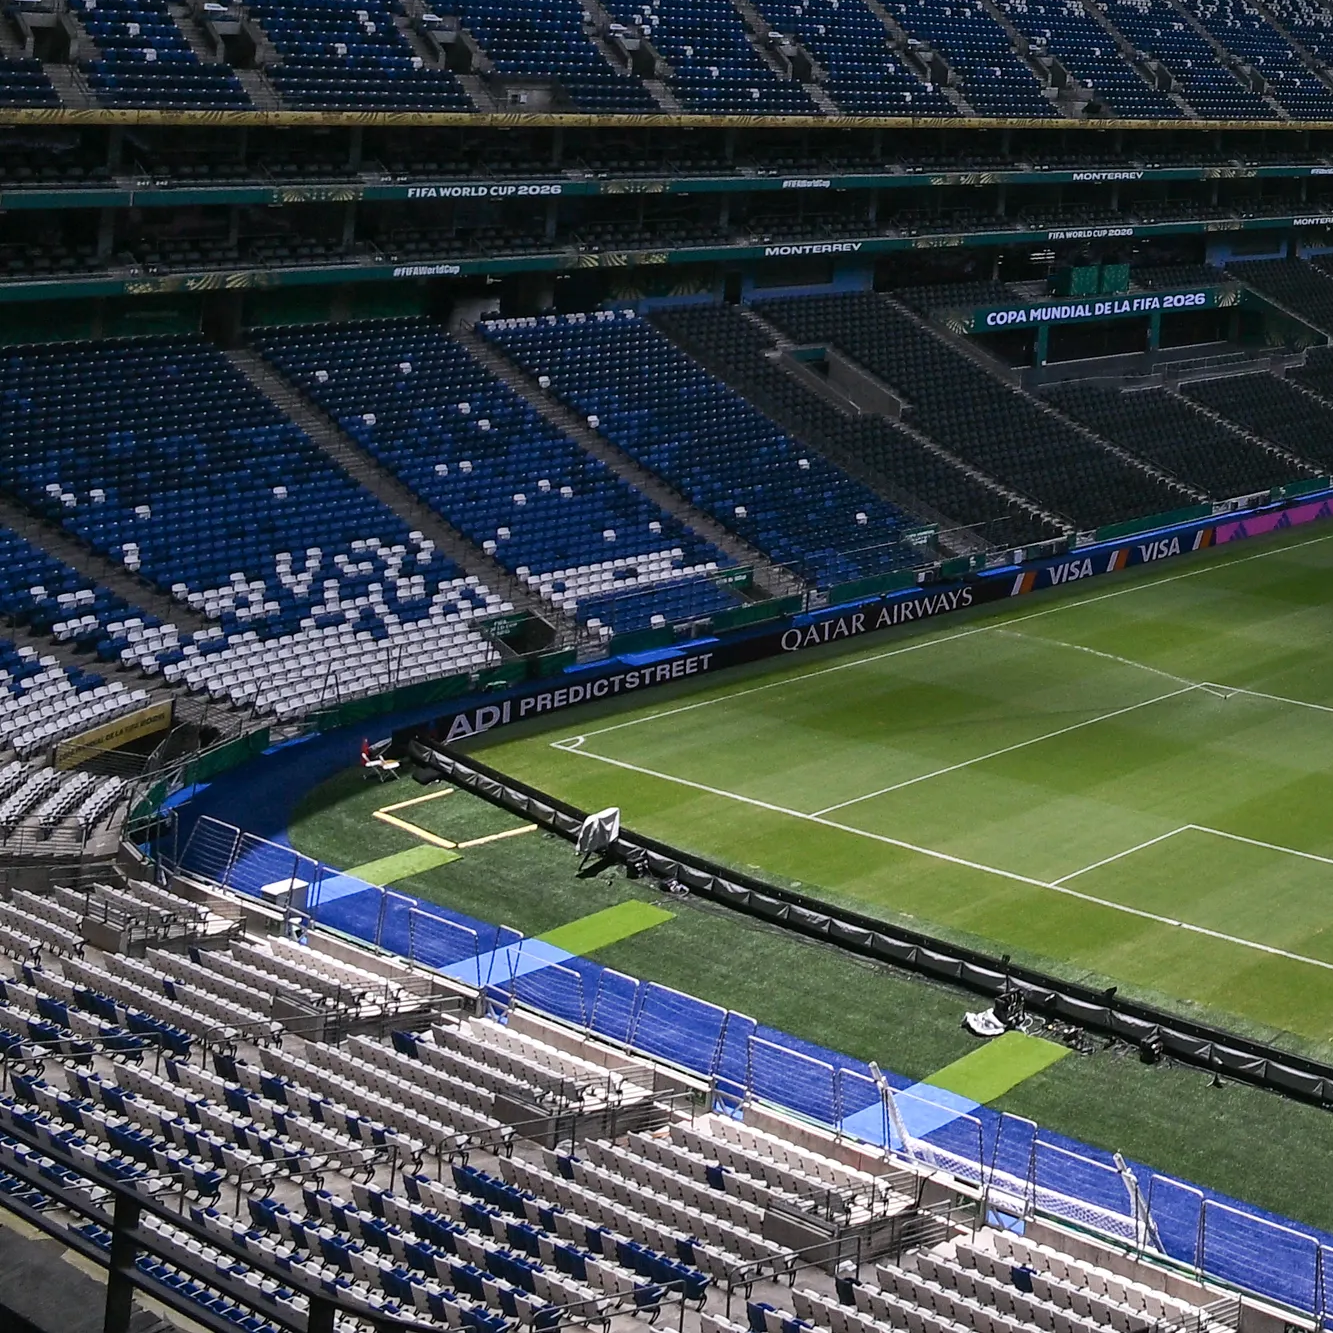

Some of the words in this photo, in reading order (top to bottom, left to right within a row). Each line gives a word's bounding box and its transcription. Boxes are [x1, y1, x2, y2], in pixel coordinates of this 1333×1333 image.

[1072, 171, 1144, 181] MONTERREY
[407, 187, 436, 198] FIFA
[439, 186, 488, 197] WORLD
[490, 186, 516, 196] CUP
[517, 184, 562, 195] 2026
[1048, 231, 1065, 240] FIFA
[1065, 230, 1092, 239] WORLD
[1093, 229, 1107, 238] CUP
[765, 242, 863, 257] MONTERREY
[393, 264, 460, 277] #FIFAWorldCup
[986, 310, 1027, 326] COPA
[1028, 305, 1092, 322] MUNDIAL
[1094, 303, 1112, 315] DE
[1113, 301, 1131, 314] LA
[1133, 298, 1160, 312] FIFA
[1162, 292, 1206, 308] 2026
[1138, 536, 1180, 562] VISA
[1047, 557, 1093, 585] VISA
[780, 612, 866, 651] QATAR
[875, 586, 973, 629] AIRWAYS
[448, 700, 511, 739] ADI
[519, 653, 713, 717] PREDICTSTREET
